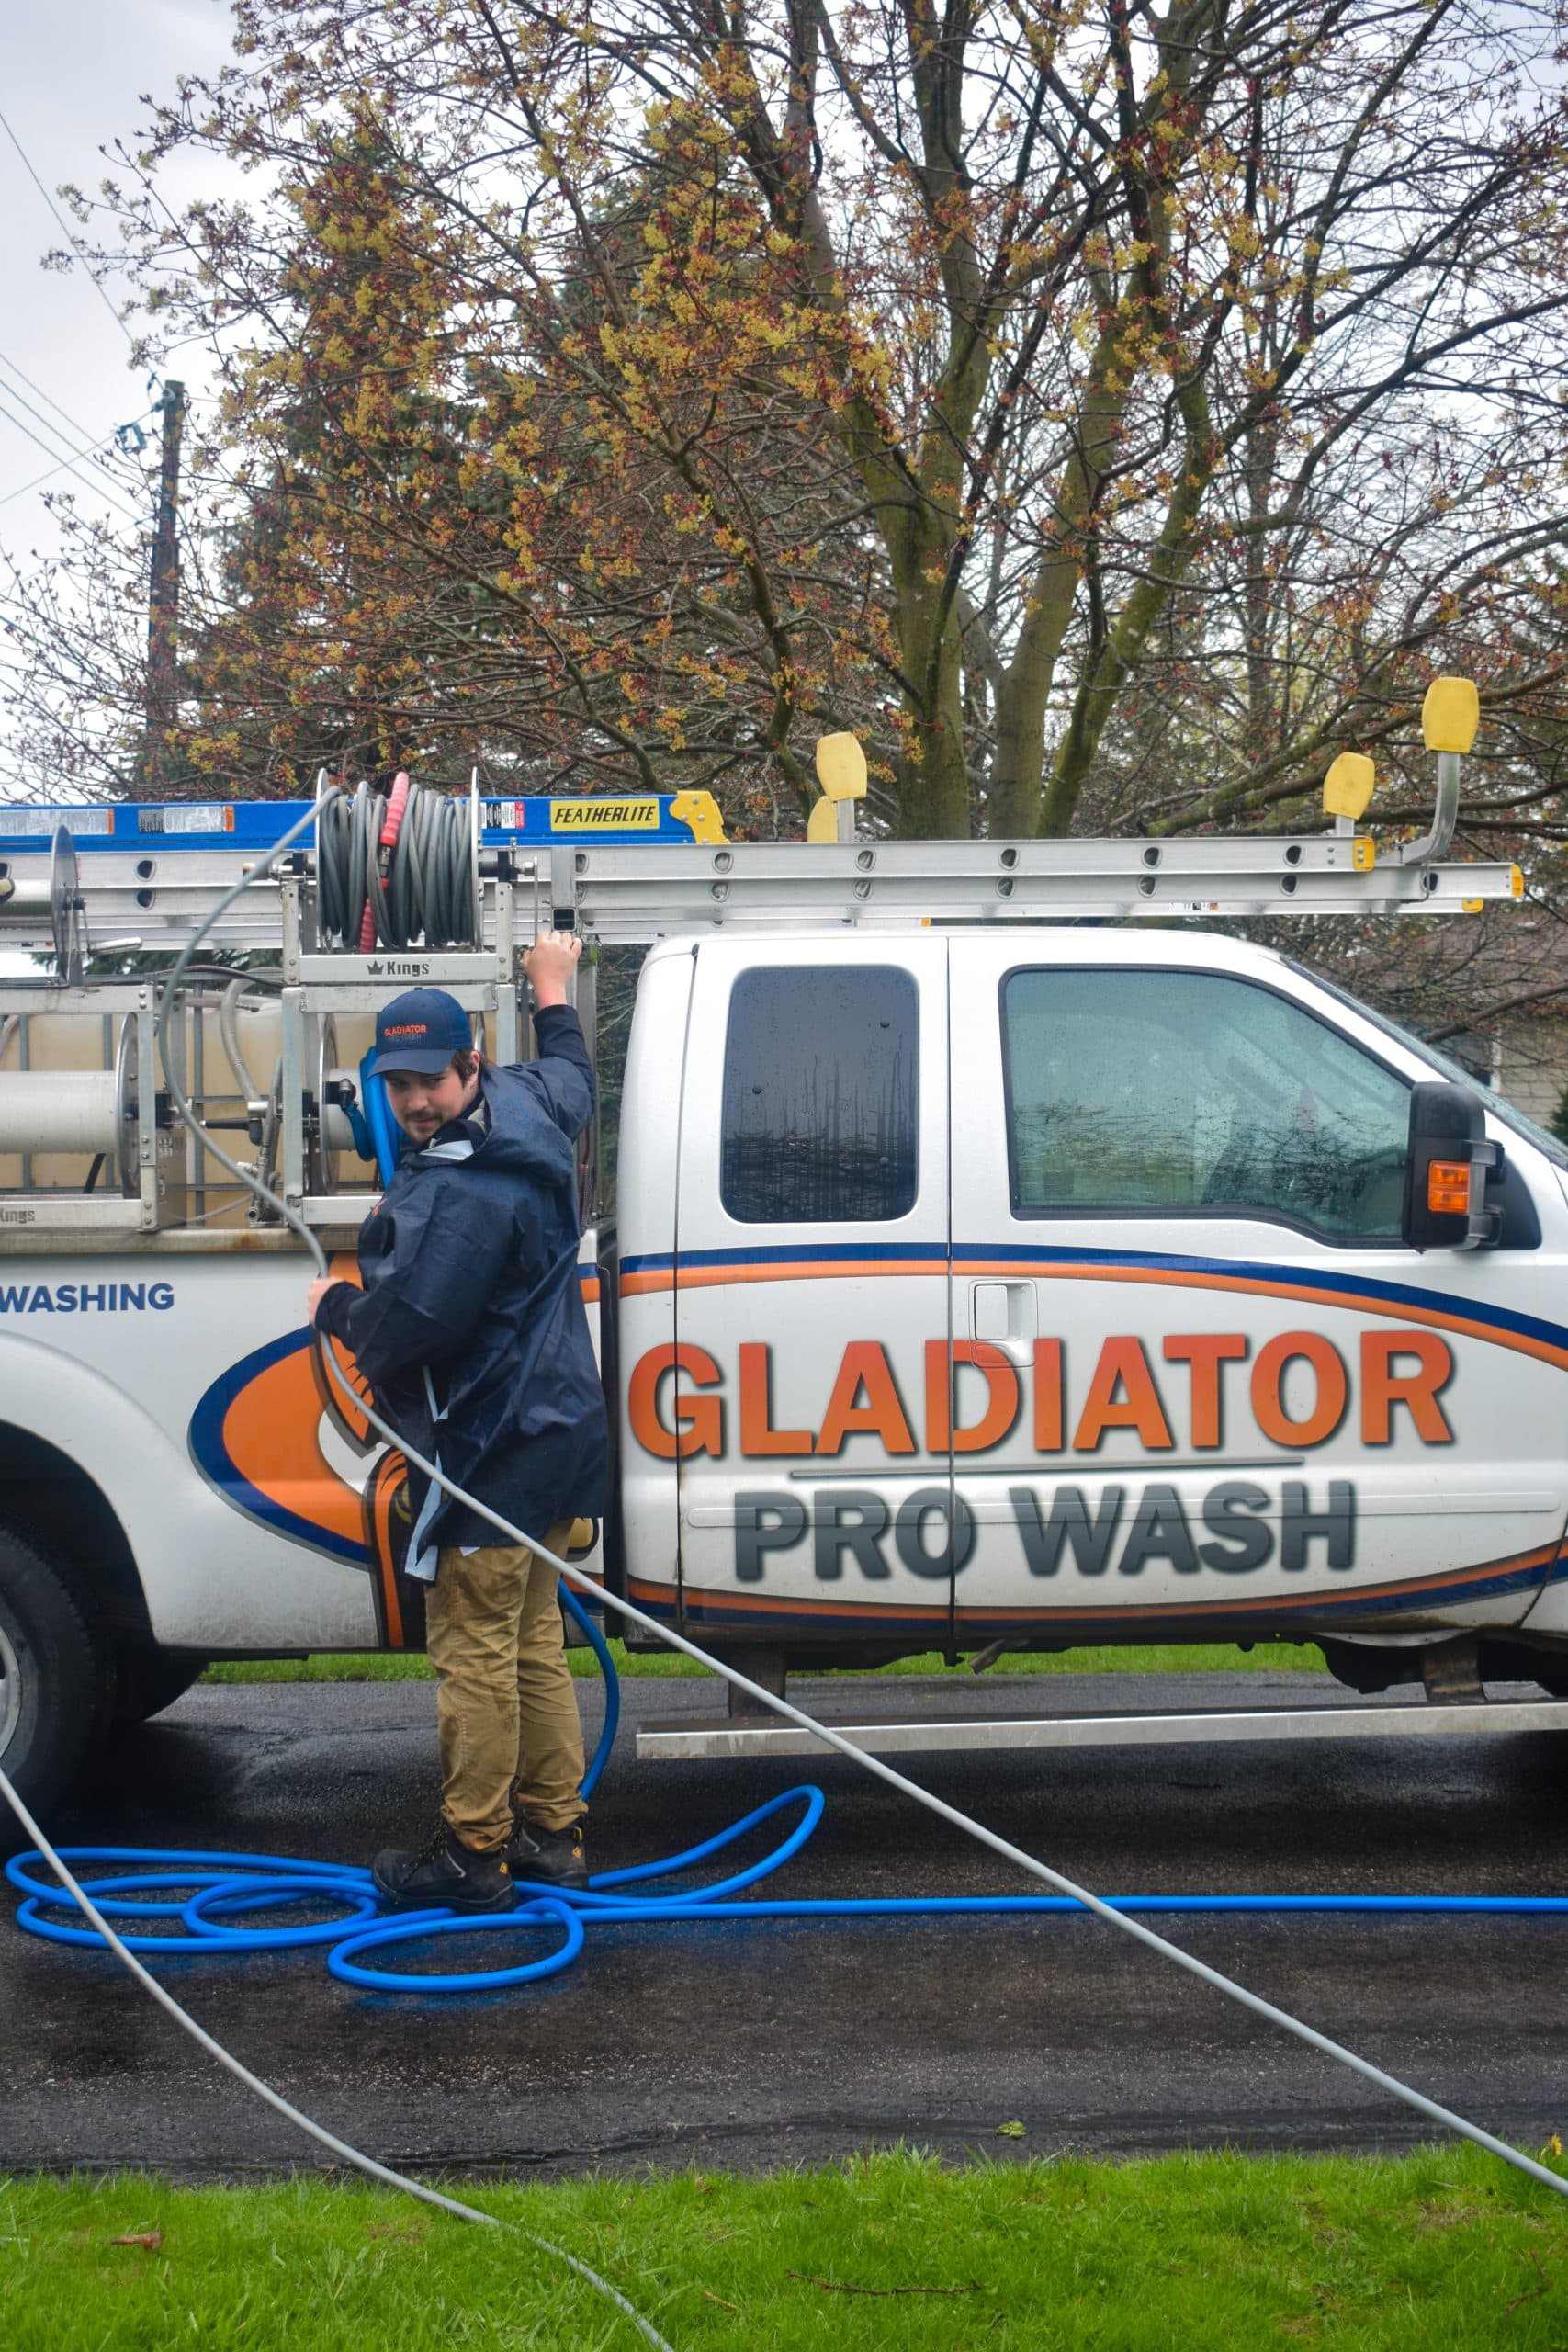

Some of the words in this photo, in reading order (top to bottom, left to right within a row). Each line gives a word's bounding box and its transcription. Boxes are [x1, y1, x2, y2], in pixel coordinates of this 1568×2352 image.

[555, 806, 656, 823] FEATHERLITE
[387, 961, 430, 977] Kings
[384, 1024, 427, 1036] GLADIATOR
[0, 1283, 175, 1313] WASHING
[628, 1330, 1454, 1459] GLADIATOR
[735, 1487, 976, 1581] PRO
[1009, 1480, 1356, 1577] WASH
